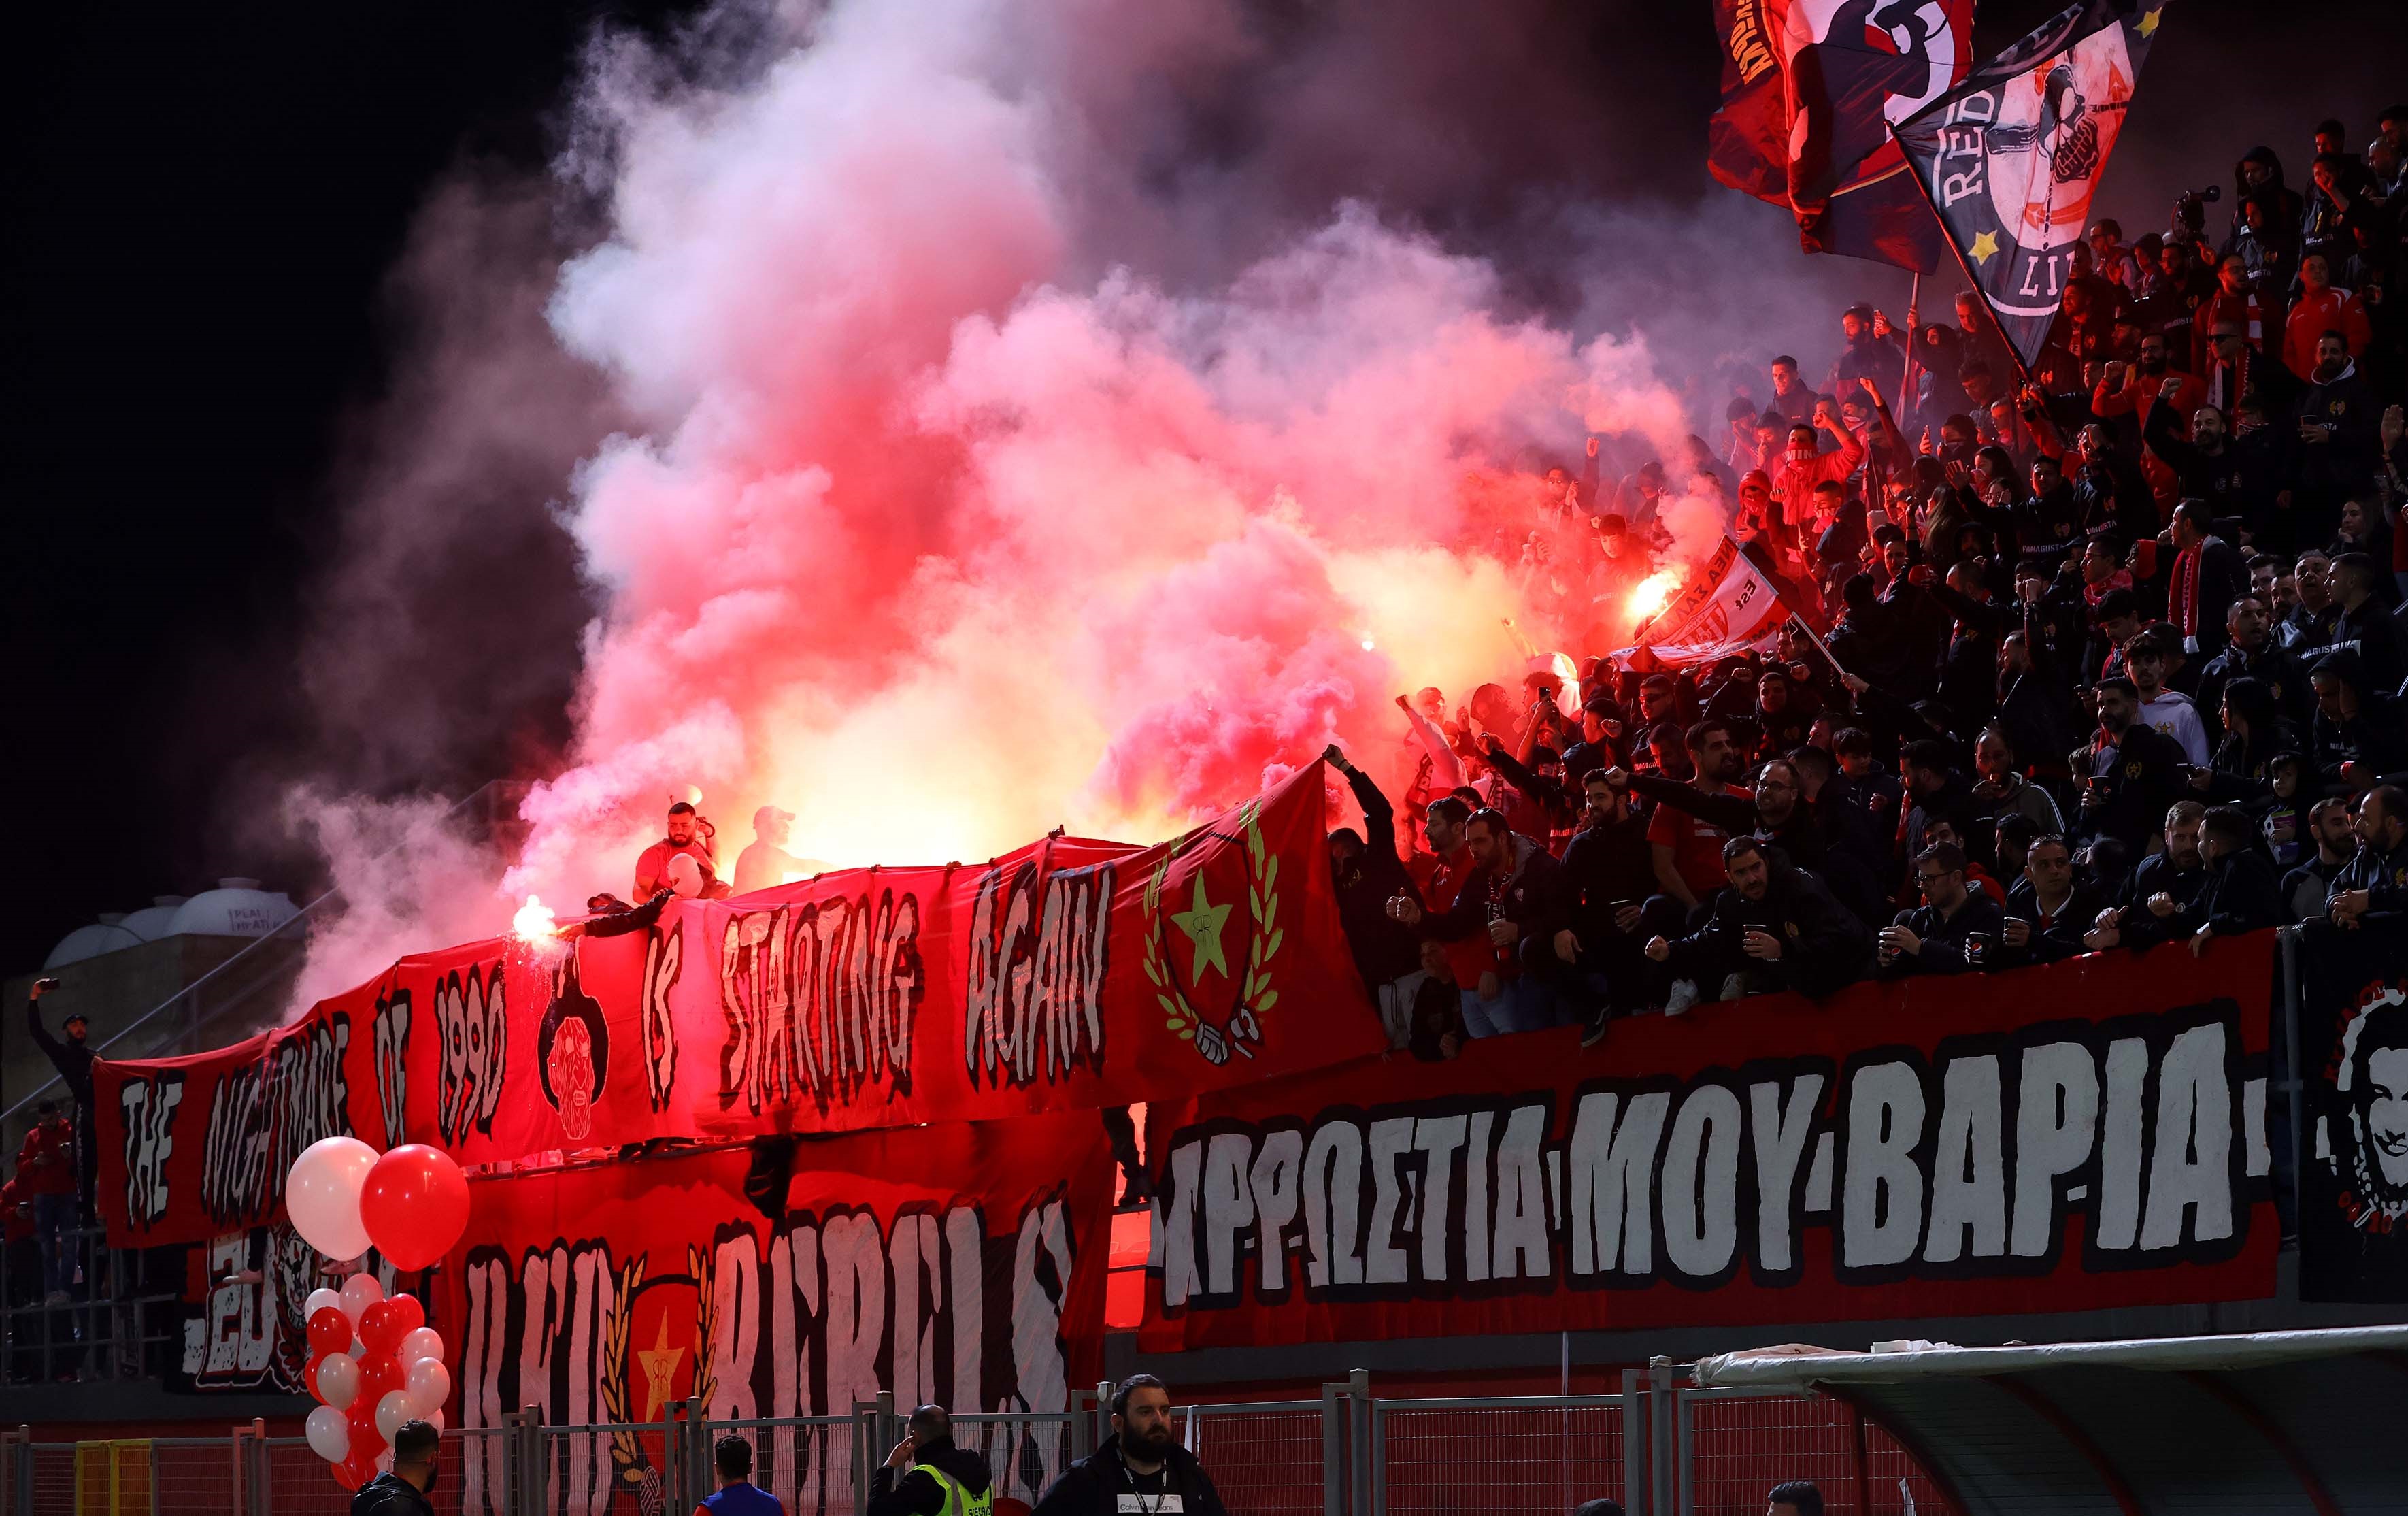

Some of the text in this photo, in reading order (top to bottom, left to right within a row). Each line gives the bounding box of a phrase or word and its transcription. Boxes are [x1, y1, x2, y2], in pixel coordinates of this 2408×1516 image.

[1943, 89, 1996, 208] RED
[122, 1079, 184, 1226] THE
[375, 1002, 411, 1150] OF
[437, 964, 507, 1140] 1990
[642, 929, 680, 1097] IS
[722, 897, 916, 1109] STARTING
[966, 870, 1112, 1083] AGAIN
